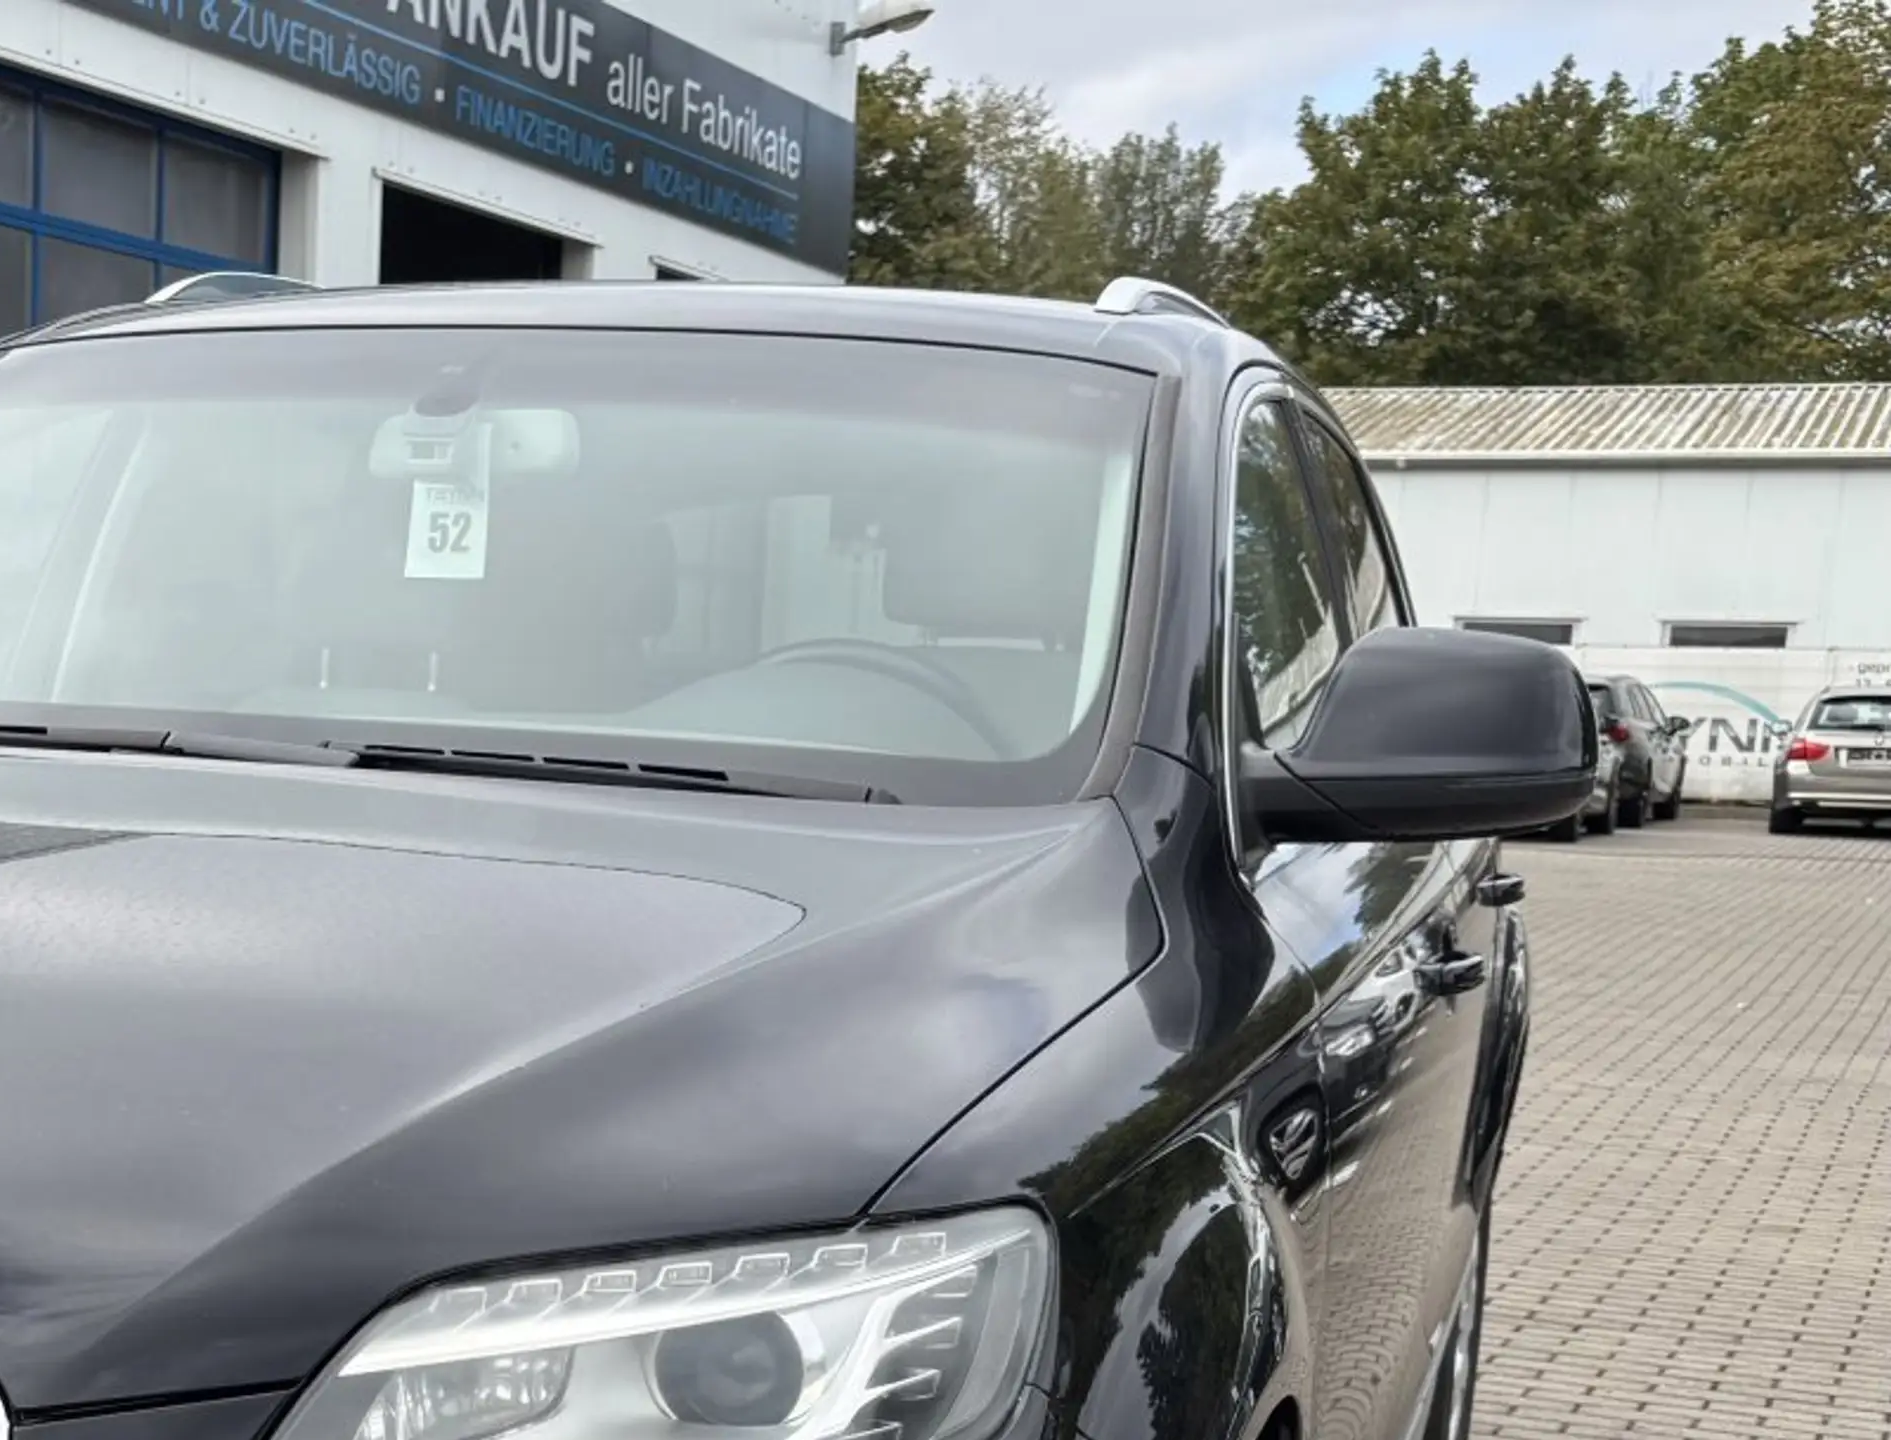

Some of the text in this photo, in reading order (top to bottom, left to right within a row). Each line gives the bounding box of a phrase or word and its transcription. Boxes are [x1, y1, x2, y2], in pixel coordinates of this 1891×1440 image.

[229, 0, 421, 104] ZUVERLÄSSIG
[456, 84, 615, 178] FINANZIERUNG
[606, 53, 674, 125] aller
[681, 78, 802, 180] Fabrikate
[427, 511, 472, 554] 52
